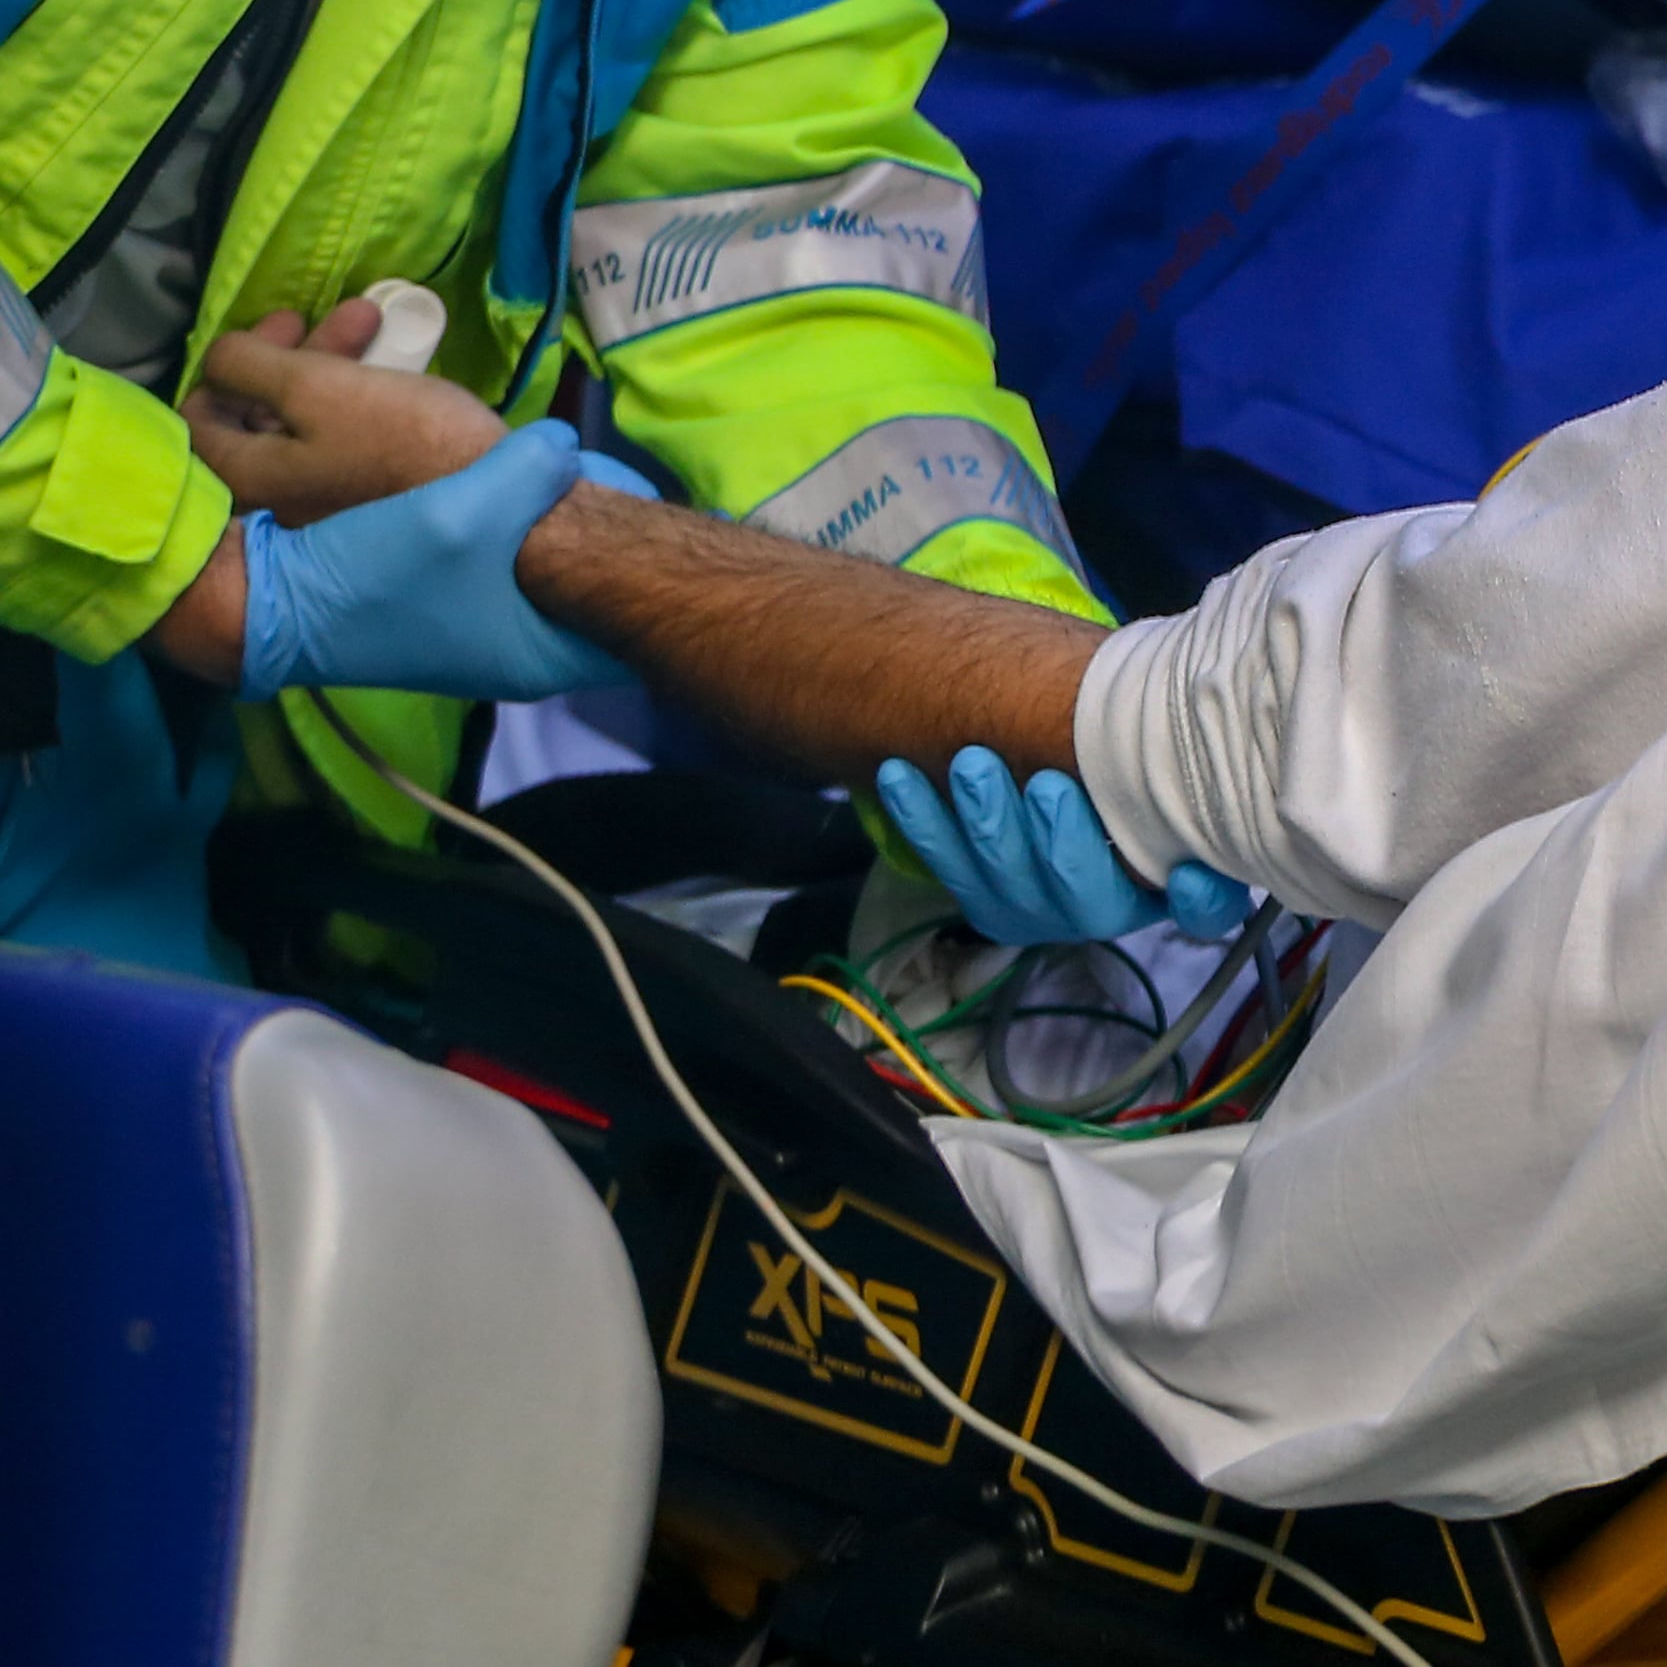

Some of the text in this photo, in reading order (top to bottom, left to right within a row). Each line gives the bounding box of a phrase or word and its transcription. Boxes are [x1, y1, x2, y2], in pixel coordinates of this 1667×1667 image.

[898, 222, 950, 254] 112
[915, 453, 984, 480] 112
[747, 1240, 922, 1381] XPS
